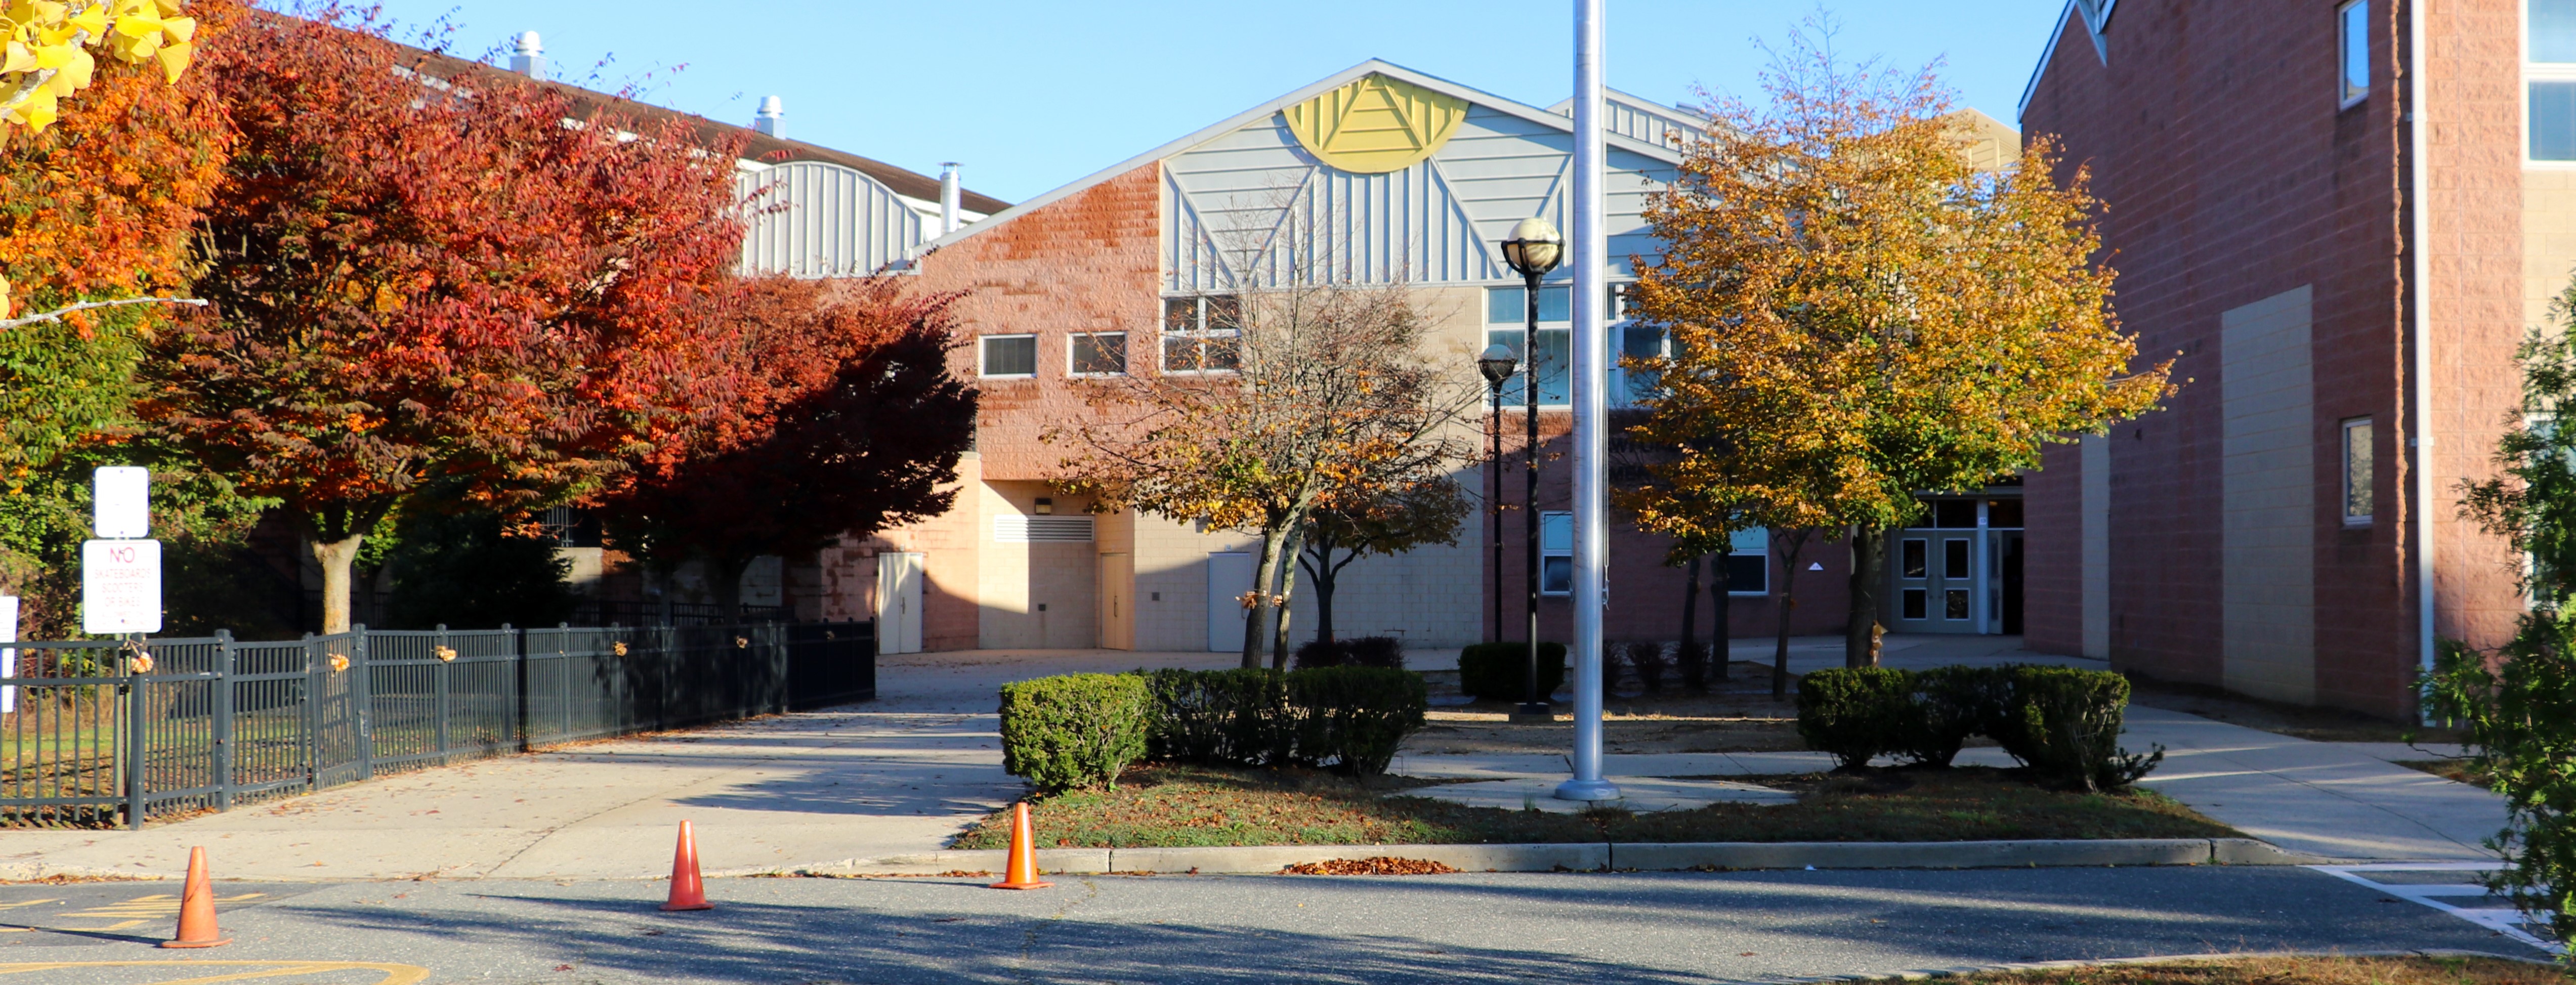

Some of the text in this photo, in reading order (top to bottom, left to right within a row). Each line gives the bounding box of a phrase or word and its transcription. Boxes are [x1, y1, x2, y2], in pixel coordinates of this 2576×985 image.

[110, 546, 135, 564] NO
[95, 568, 150, 579] SKATEBOARDS
[102, 582, 143, 593] SCOOTERS
[105, 596, 140, 607] OR BIKES
